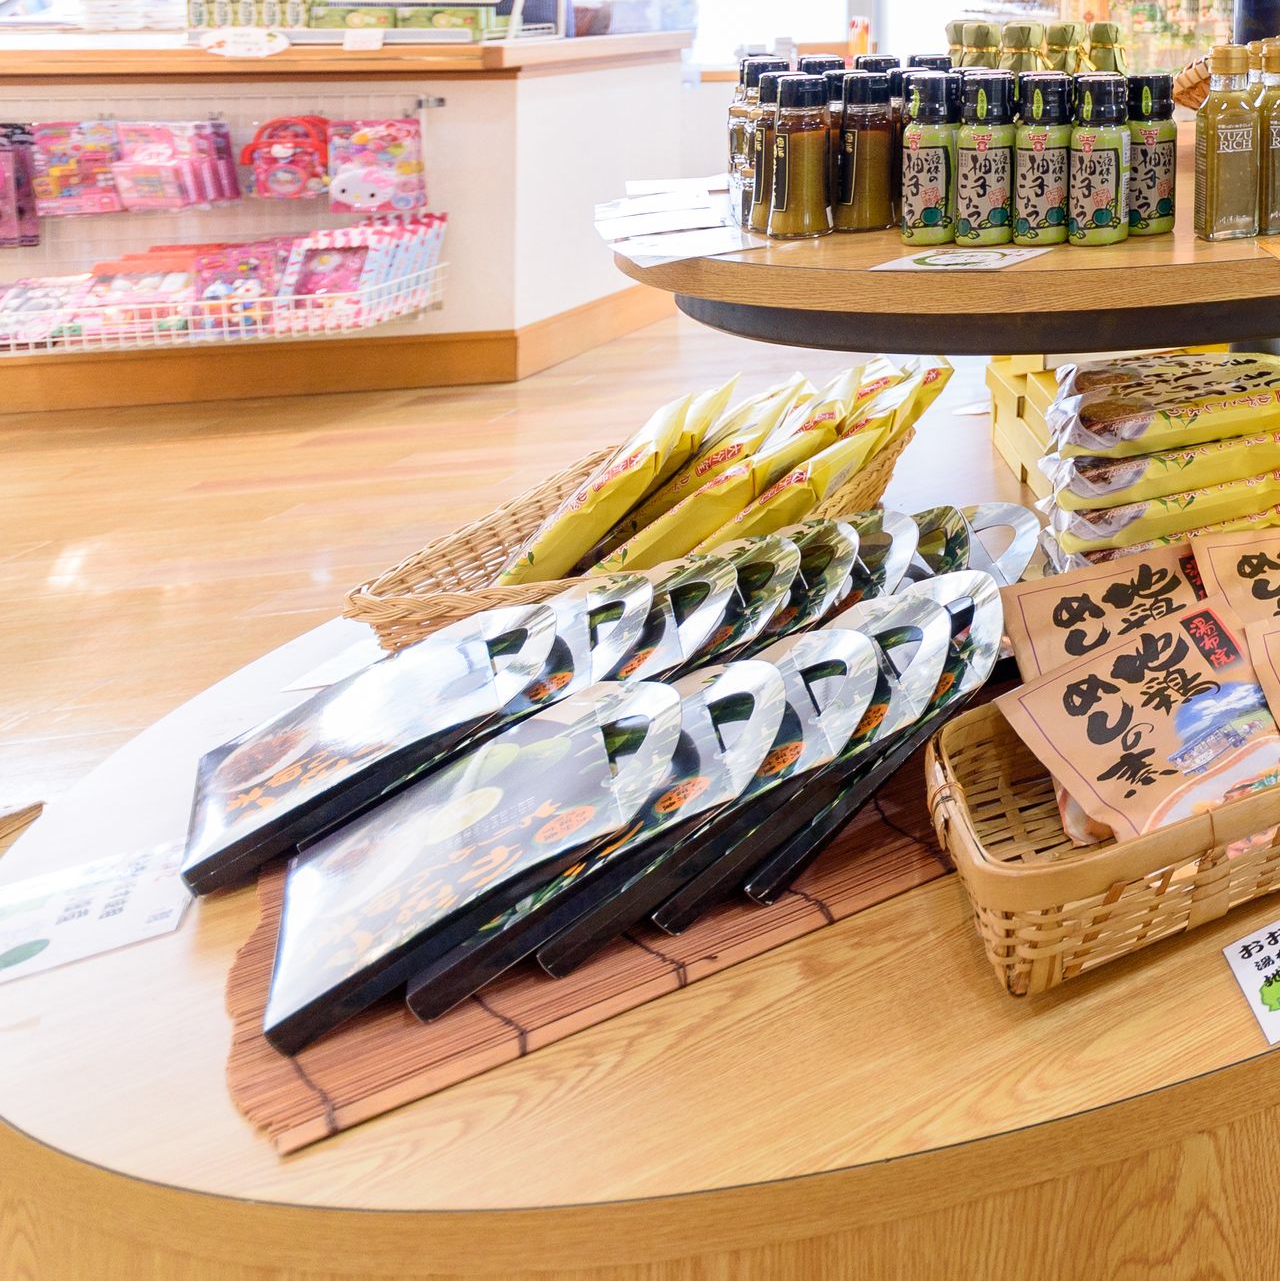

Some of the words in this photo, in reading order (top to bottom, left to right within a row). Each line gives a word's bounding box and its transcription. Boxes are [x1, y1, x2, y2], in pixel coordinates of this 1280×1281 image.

[1217, 131, 1253, 142] YUZU
[1219, 140, 1252, 151] RICH
[1187, 617, 1235, 668] 湯布院
[1111, 632, 1222, 716] 地鶏
[1062, 673, 1179, 799] めしの素
